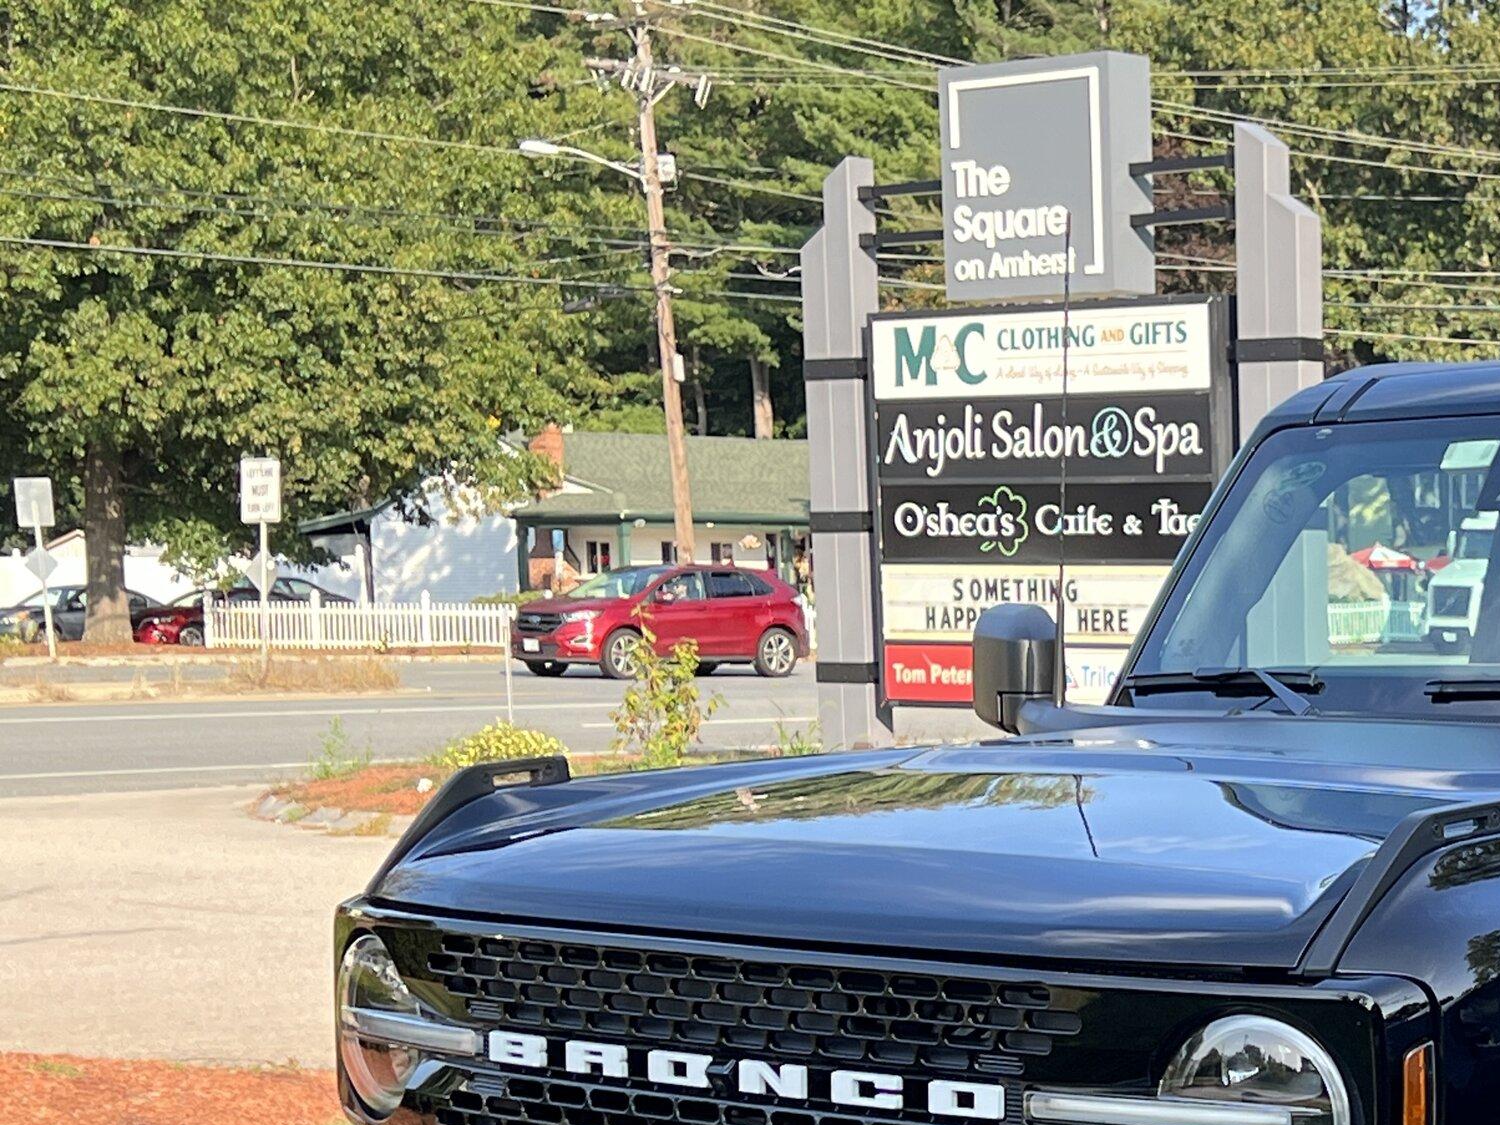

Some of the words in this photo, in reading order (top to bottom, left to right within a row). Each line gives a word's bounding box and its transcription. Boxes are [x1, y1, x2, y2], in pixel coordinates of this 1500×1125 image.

[951, 160, 1011, 198] The
[953, 205, 1069, 249] Square
[954, 258, 985, 281] on
[987, 246, 1076, 279] Amherst
[997, 324, 1095, 351] CLOTHING
[1101, 328, 1125, 343] AND
[1129, 320, 1187, 346] GIFTS
[884, 404, 986, 477] Anjoli
[992, 402, 1089, 459] Salon
[1133, 406, 1203, 473] Spa
[1123, 514, 1143, 535] &
[953, 578, 1078, 602] SOMETHING
[925, 606, 987, 630] HAPP
[1077, 609, 1129, 632] HERE
[892, 662, 927, 684] Tom
[488, 1028, 1006, 1121] BRONCO
